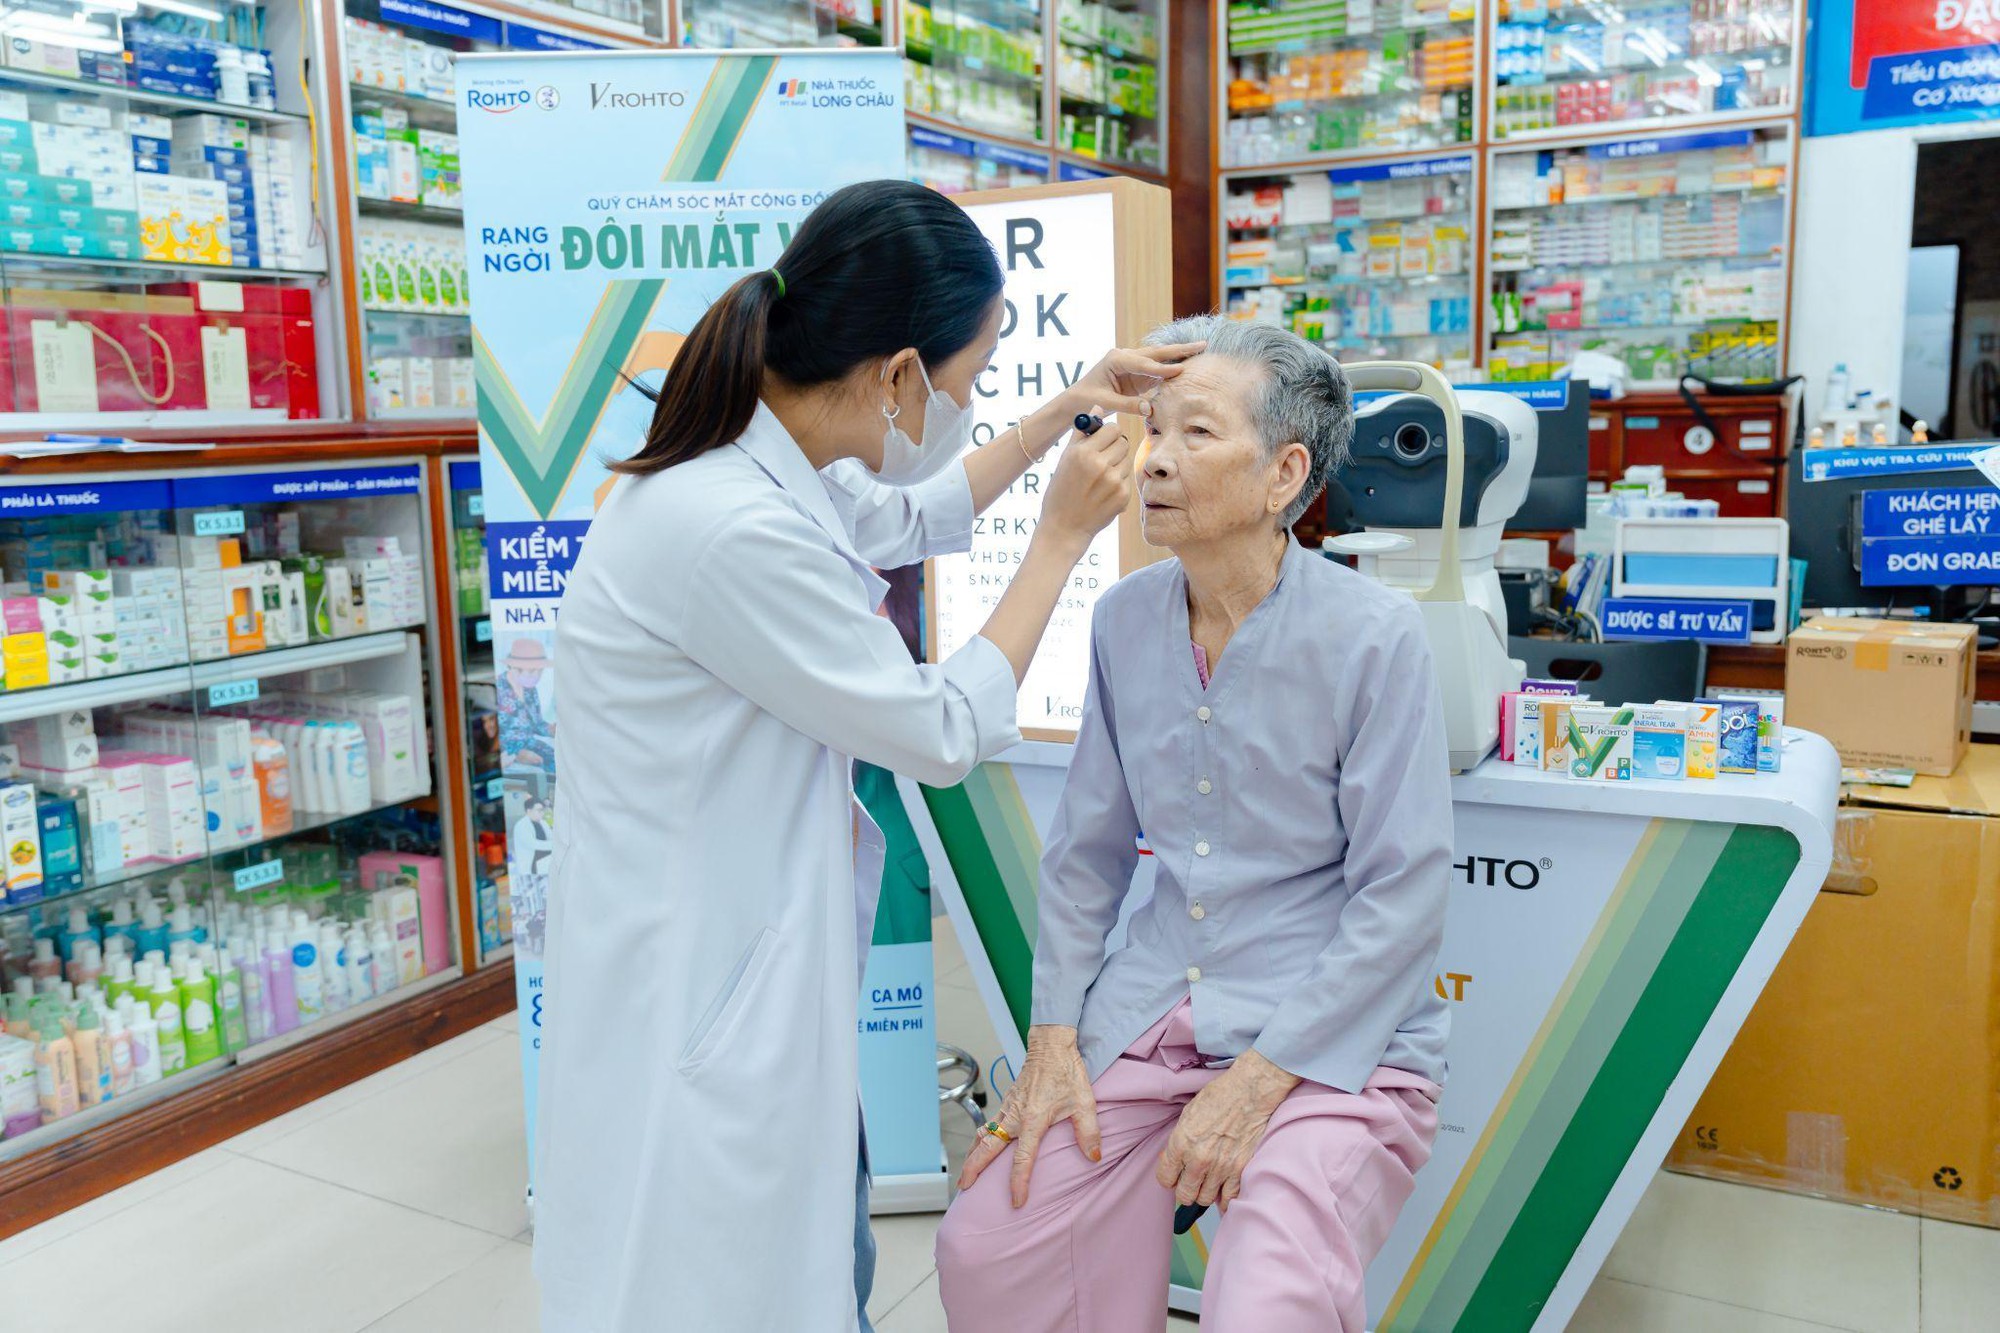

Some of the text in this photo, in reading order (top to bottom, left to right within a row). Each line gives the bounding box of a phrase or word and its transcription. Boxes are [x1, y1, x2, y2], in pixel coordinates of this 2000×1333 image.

[812, 76, 876, 90] NHÀ THUỐC
[812, 92, 894, 107] LONG CHÂU
[677, 195, 711, 209] SÓC
[751, 193, 796, 209] CỘNG
[482, 226, 548, 248] RẠNG
[560, 216, 645, 271] ĐÔI
[661, 211, 760, 269] MẮT
[1006, 217, 1045, 271] R
[484, 251, 550, 273] NGỜI
[1834, 458, 1859, 468] KHU
[1890, 455, 1914, 465] TRA
[36, 493, 55, 507] LÀ
[1888, 490, 1961, 513] KHÁCH
[198, 518, 212, 530] CK
[1903, 510, 1991, 535] GHÉ LẤY
[500, 525, 570, 560] KIỂM
[1887, 551, 1939, 572] ĐƠN
[505, 603, 546, 623] NHÀ
[1679, 611, 1705, 631] TƯ
[1706, 608, 1744, 632] VẤN
[213, 688, 227, 700] CK
[872, 989, 893, 1003] CA
